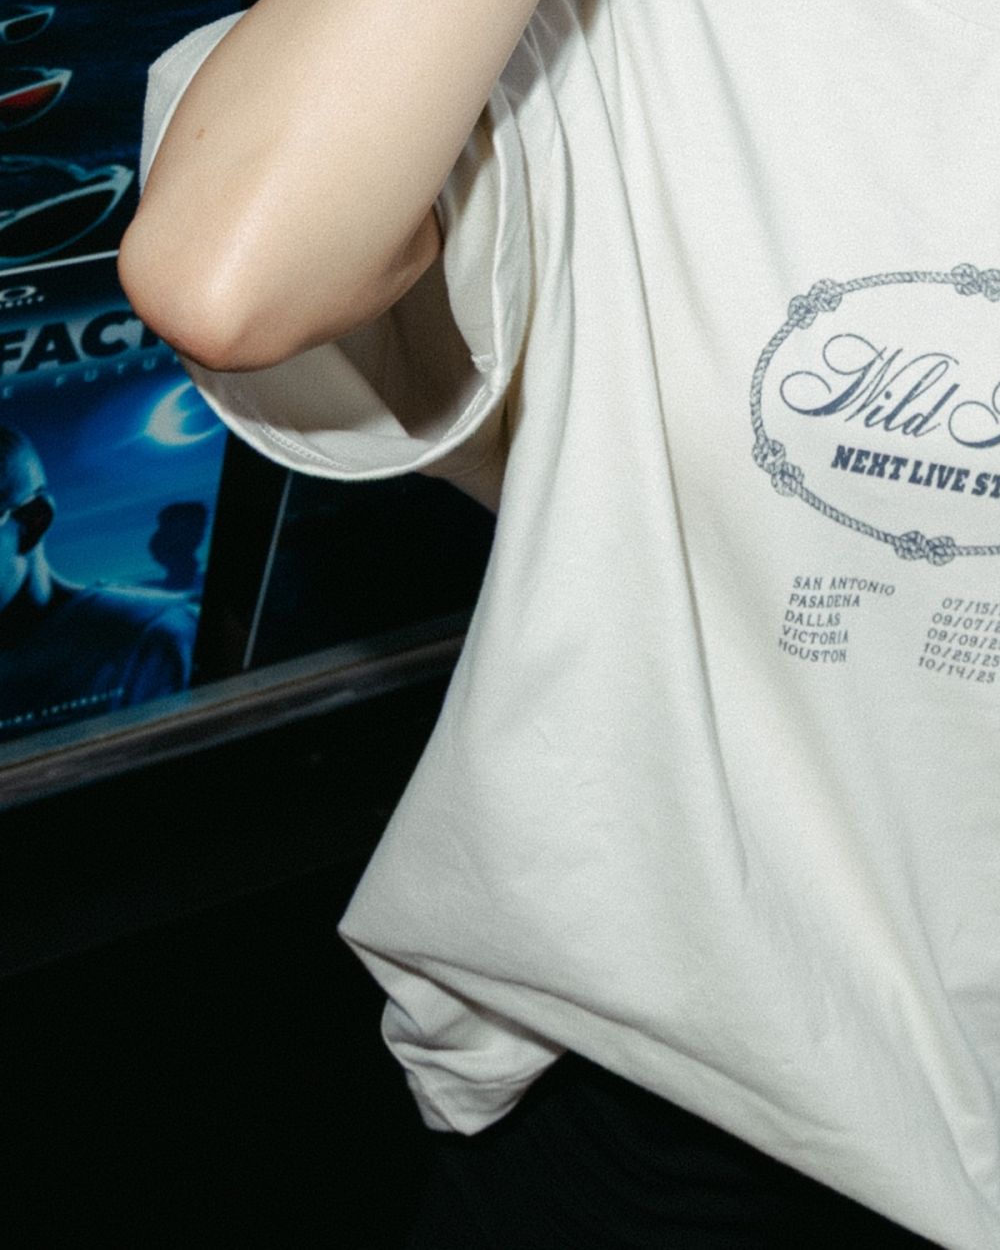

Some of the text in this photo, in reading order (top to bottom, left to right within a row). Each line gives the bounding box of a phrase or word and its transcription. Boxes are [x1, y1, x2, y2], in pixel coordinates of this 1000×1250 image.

[780, 333, 959, 438] Wild
[831, 444, 908, 483] NEXT
[909, 460, 970, 493] LIVE
[793, 576, 895, 596] SAN ANTONIO
[789, 593, 860, 608] PASADENA
[785, 609, 841, 627] DALLAS
[782, 625, 848, 645] VICTORIA
[778, 638, 847, 662] HOUSTON
[924, 643, 1000, 667] 10/25/25
[918, 657, 995, 684] 10/14/25
